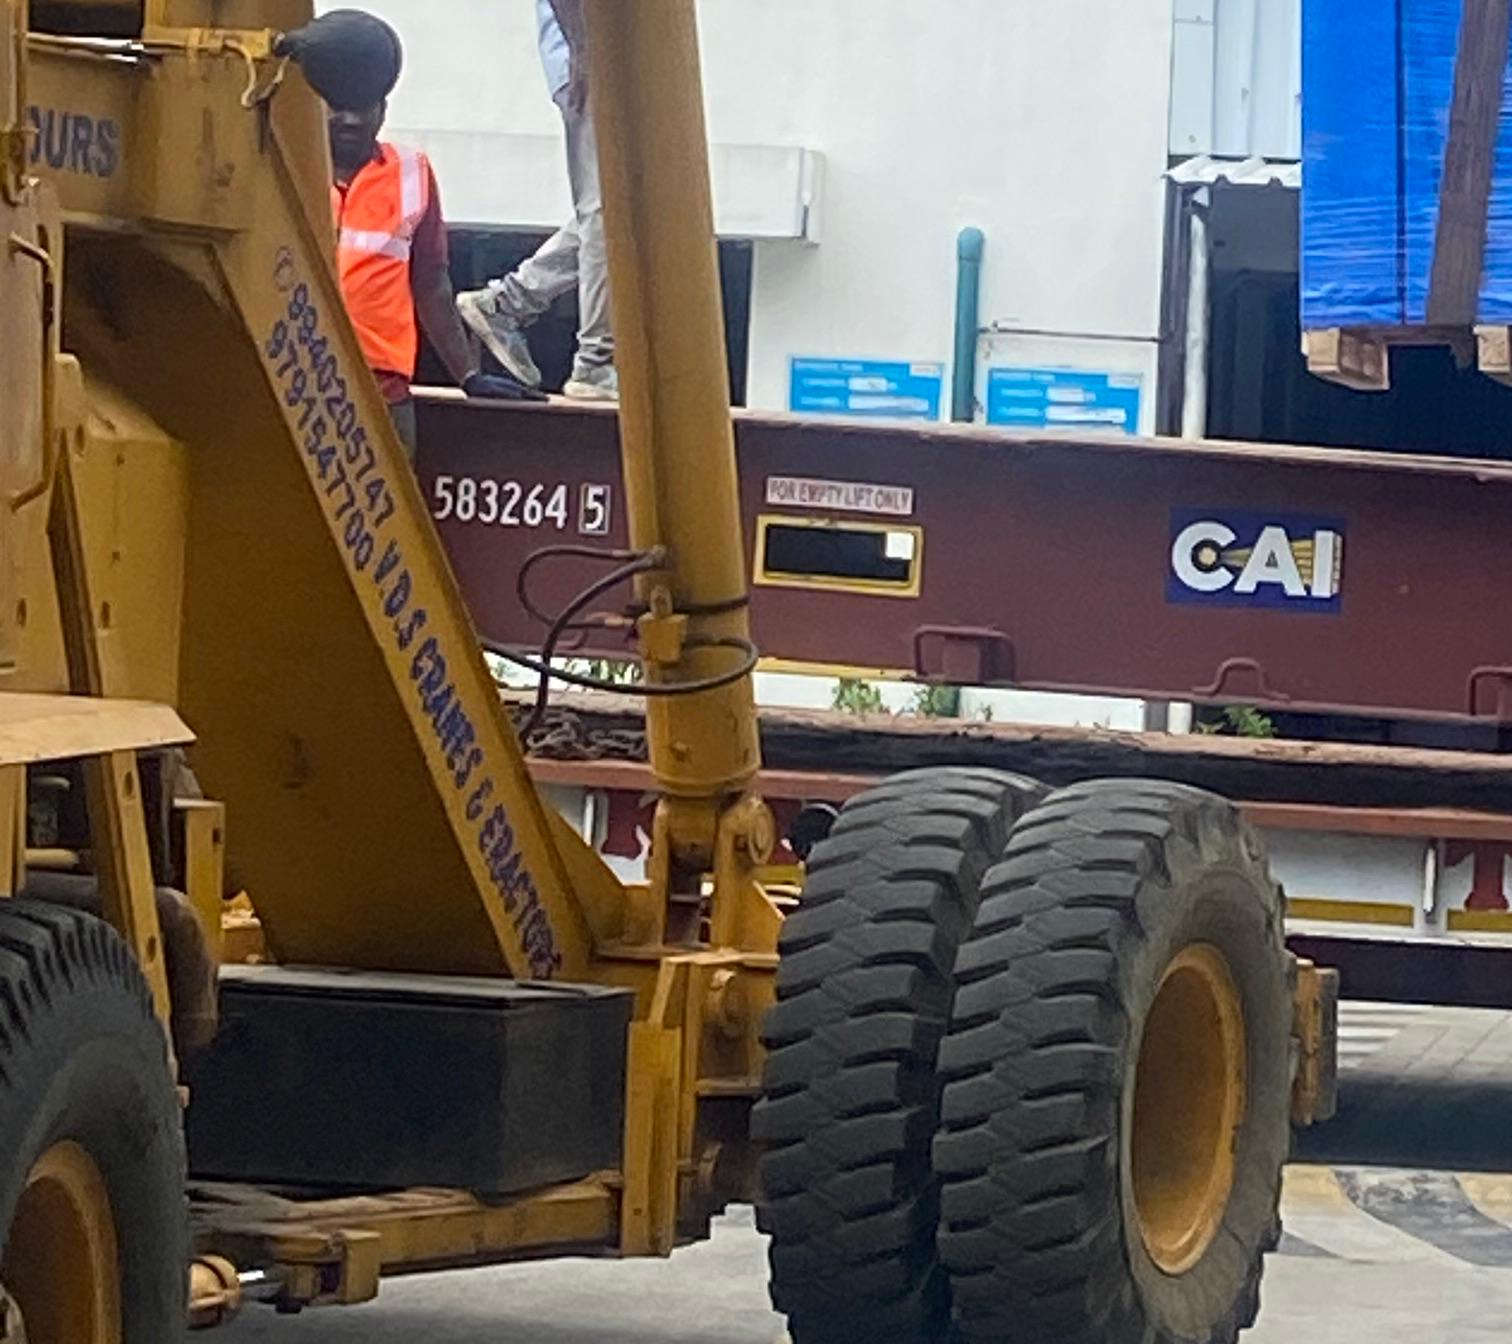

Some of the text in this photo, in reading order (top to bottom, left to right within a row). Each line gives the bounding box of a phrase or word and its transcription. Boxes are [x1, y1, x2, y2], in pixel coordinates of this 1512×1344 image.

[433, 475, 605, 530] 583264 5
[769, 479, 910, 511] FOR EMPTY LIFT ONLY
[1171, 520, 1343, 599] CAI
[409, 637, 484, 790] CRANES
